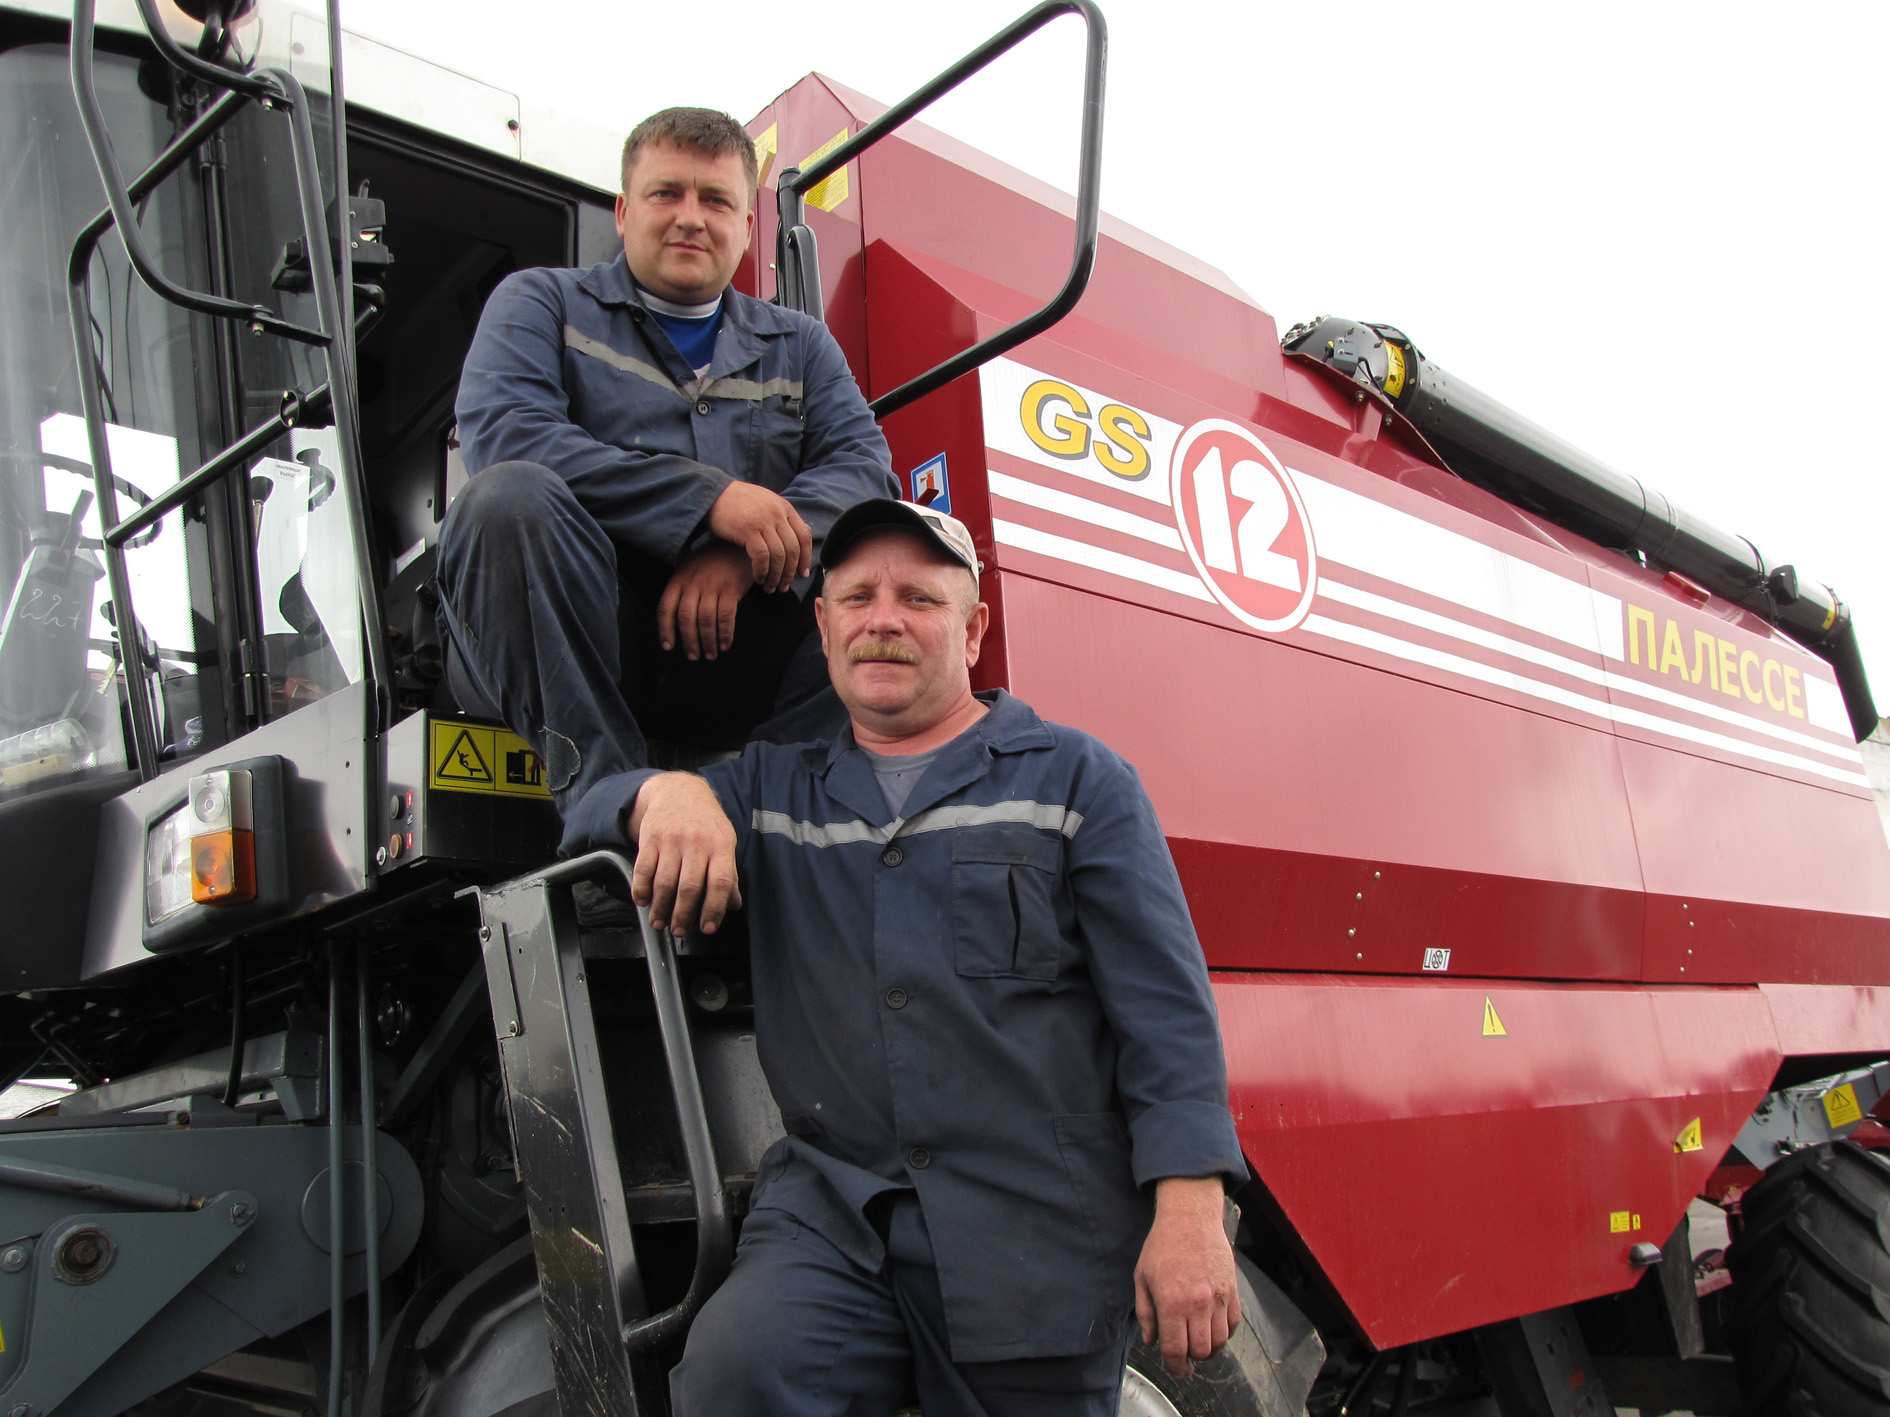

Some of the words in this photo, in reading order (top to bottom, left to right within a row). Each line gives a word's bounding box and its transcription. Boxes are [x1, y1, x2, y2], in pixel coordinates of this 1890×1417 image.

[1019, 379, 1152, 482] GS
[1192, 445, 1302, 594] 12
[1627, 603, 1805, 720] ПАЛЕССЕ
